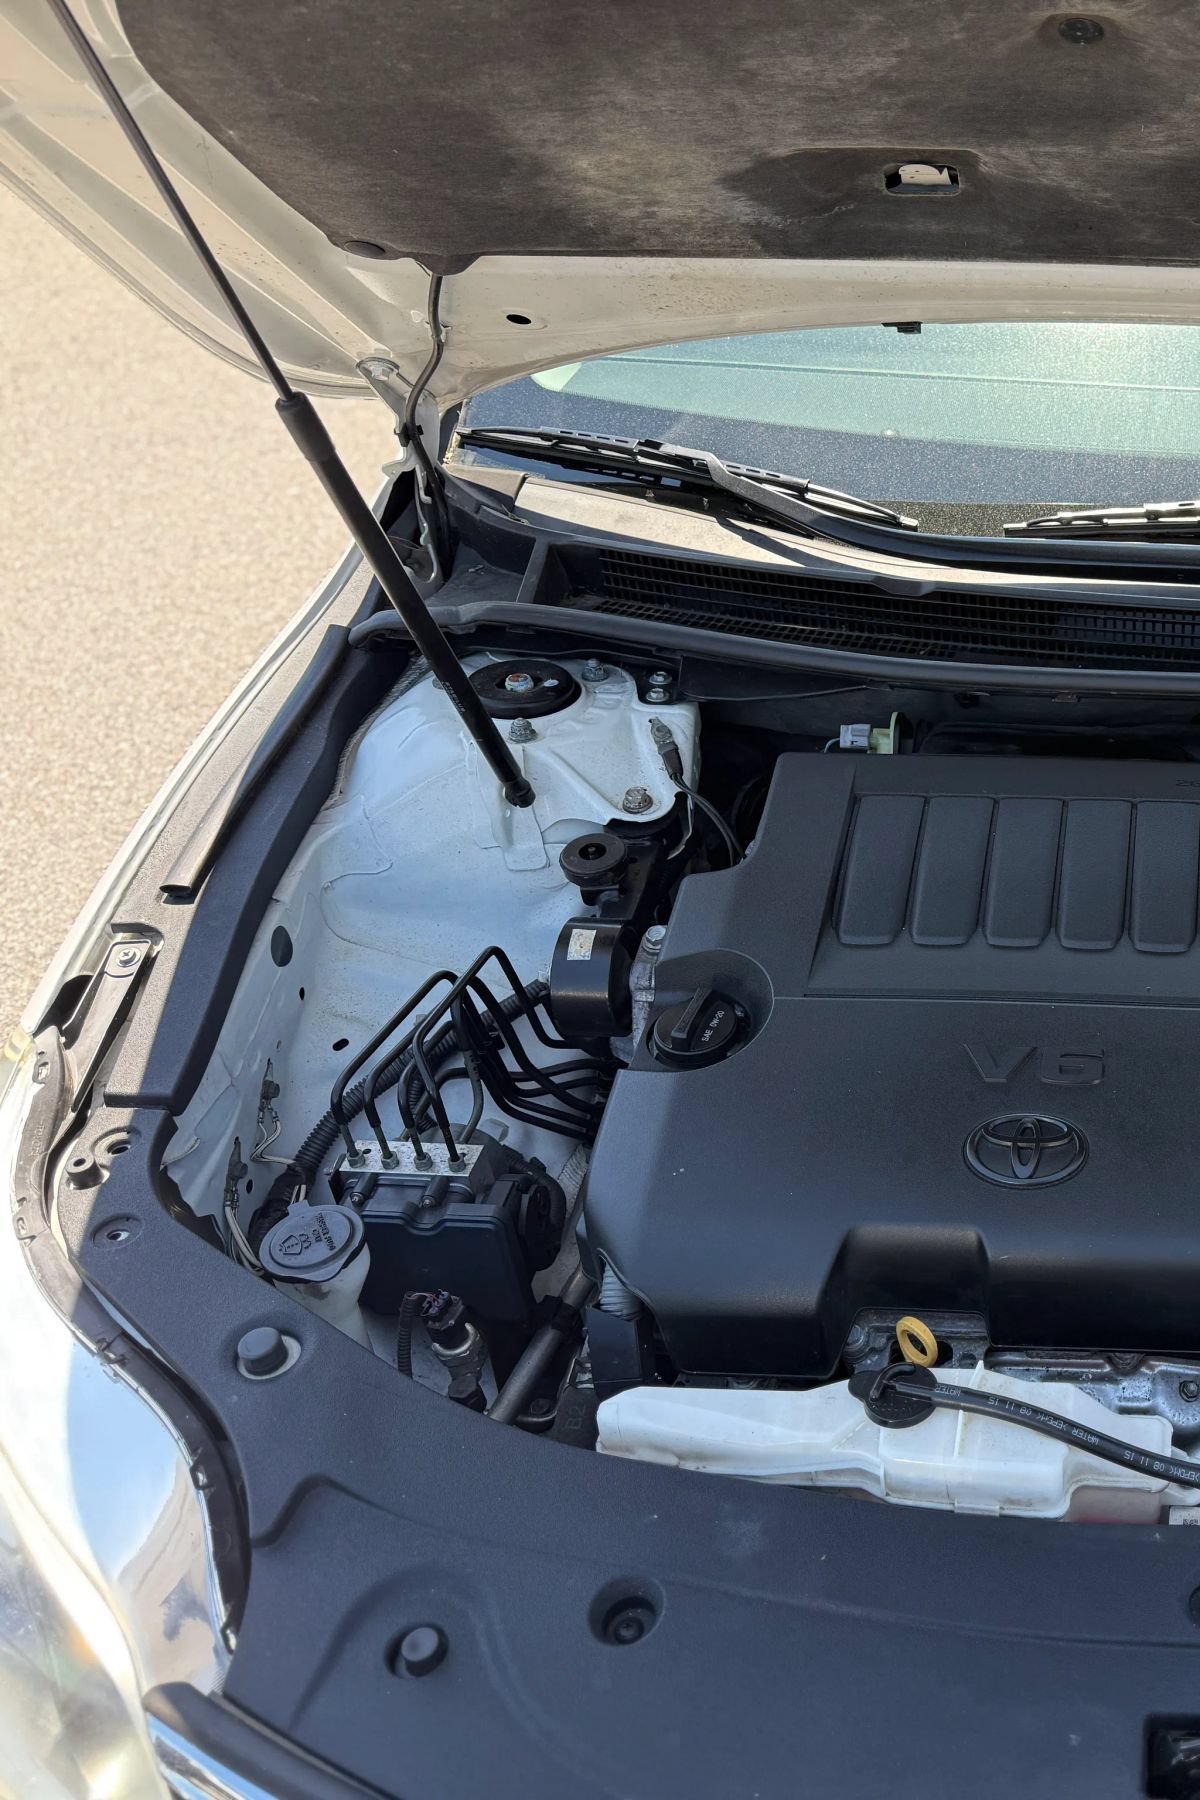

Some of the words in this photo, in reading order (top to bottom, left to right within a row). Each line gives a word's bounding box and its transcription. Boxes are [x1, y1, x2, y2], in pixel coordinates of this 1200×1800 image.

[701, 1029, 714, 1042] SAE
[710, 1010, 725, 1028] 0W-20
[963, 1042, 1106, 1086] V6
[1071, 1425, 1103, 1445] WATER
